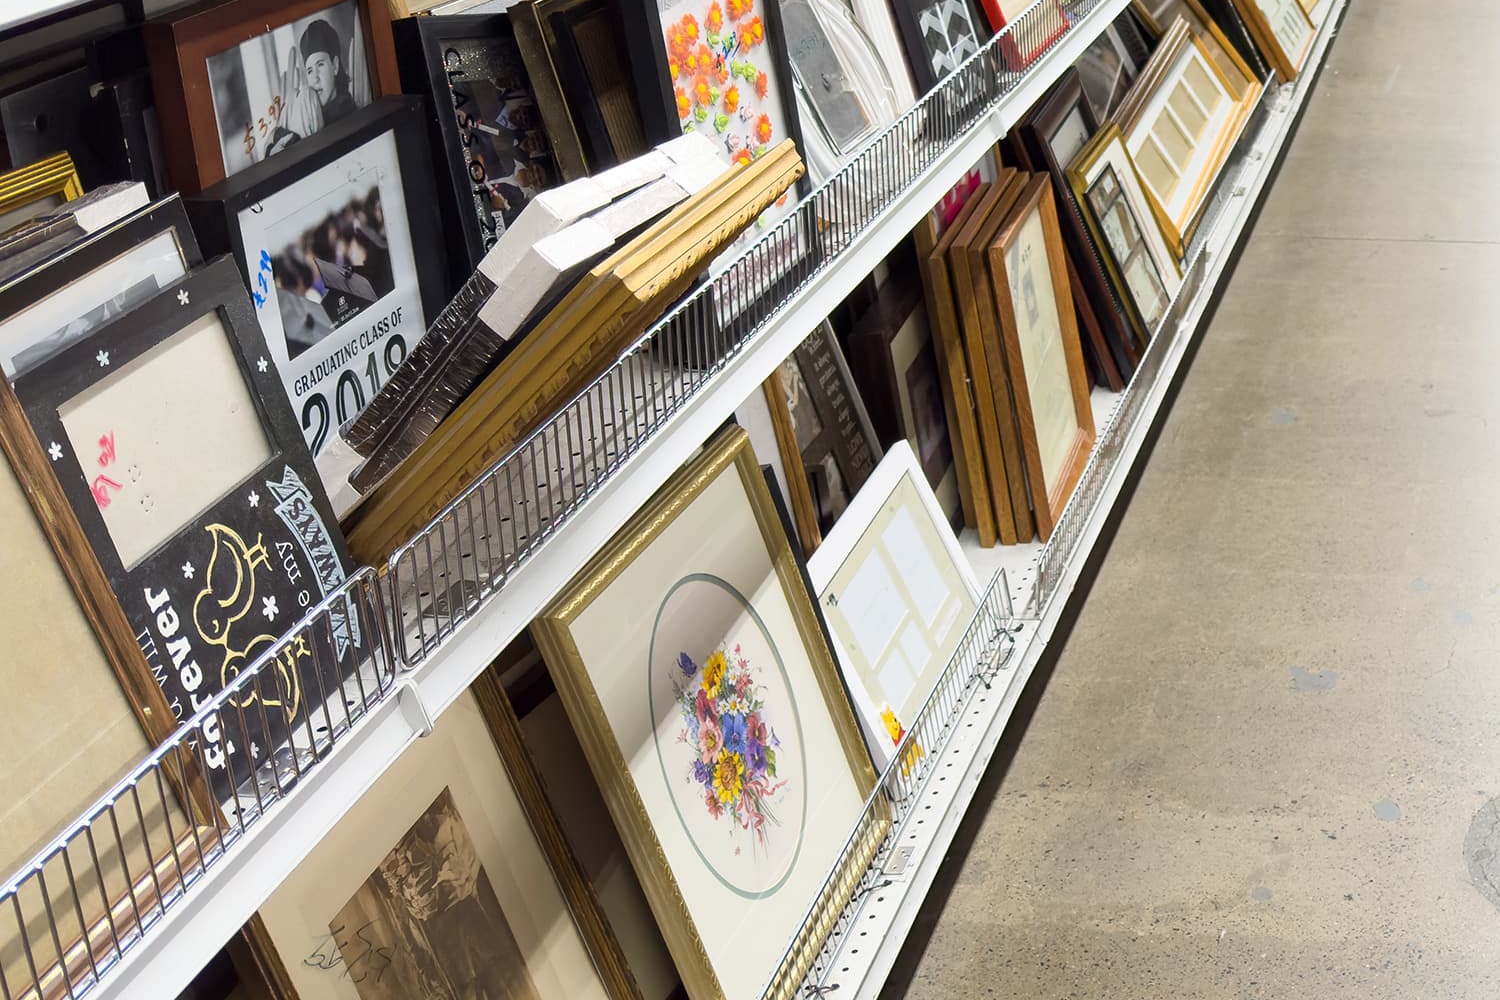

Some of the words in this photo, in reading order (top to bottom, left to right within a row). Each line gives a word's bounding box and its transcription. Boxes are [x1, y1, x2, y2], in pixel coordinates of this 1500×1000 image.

[444, 47, 479, 147] CLASS
[293, 339, 358, 397] GRADUATING
[359, 318, 390, 351] CLASS
[391, 306, 402, 328] OF
[275, 540, 302, 585] my
[144, 587, 235, 770] forever
